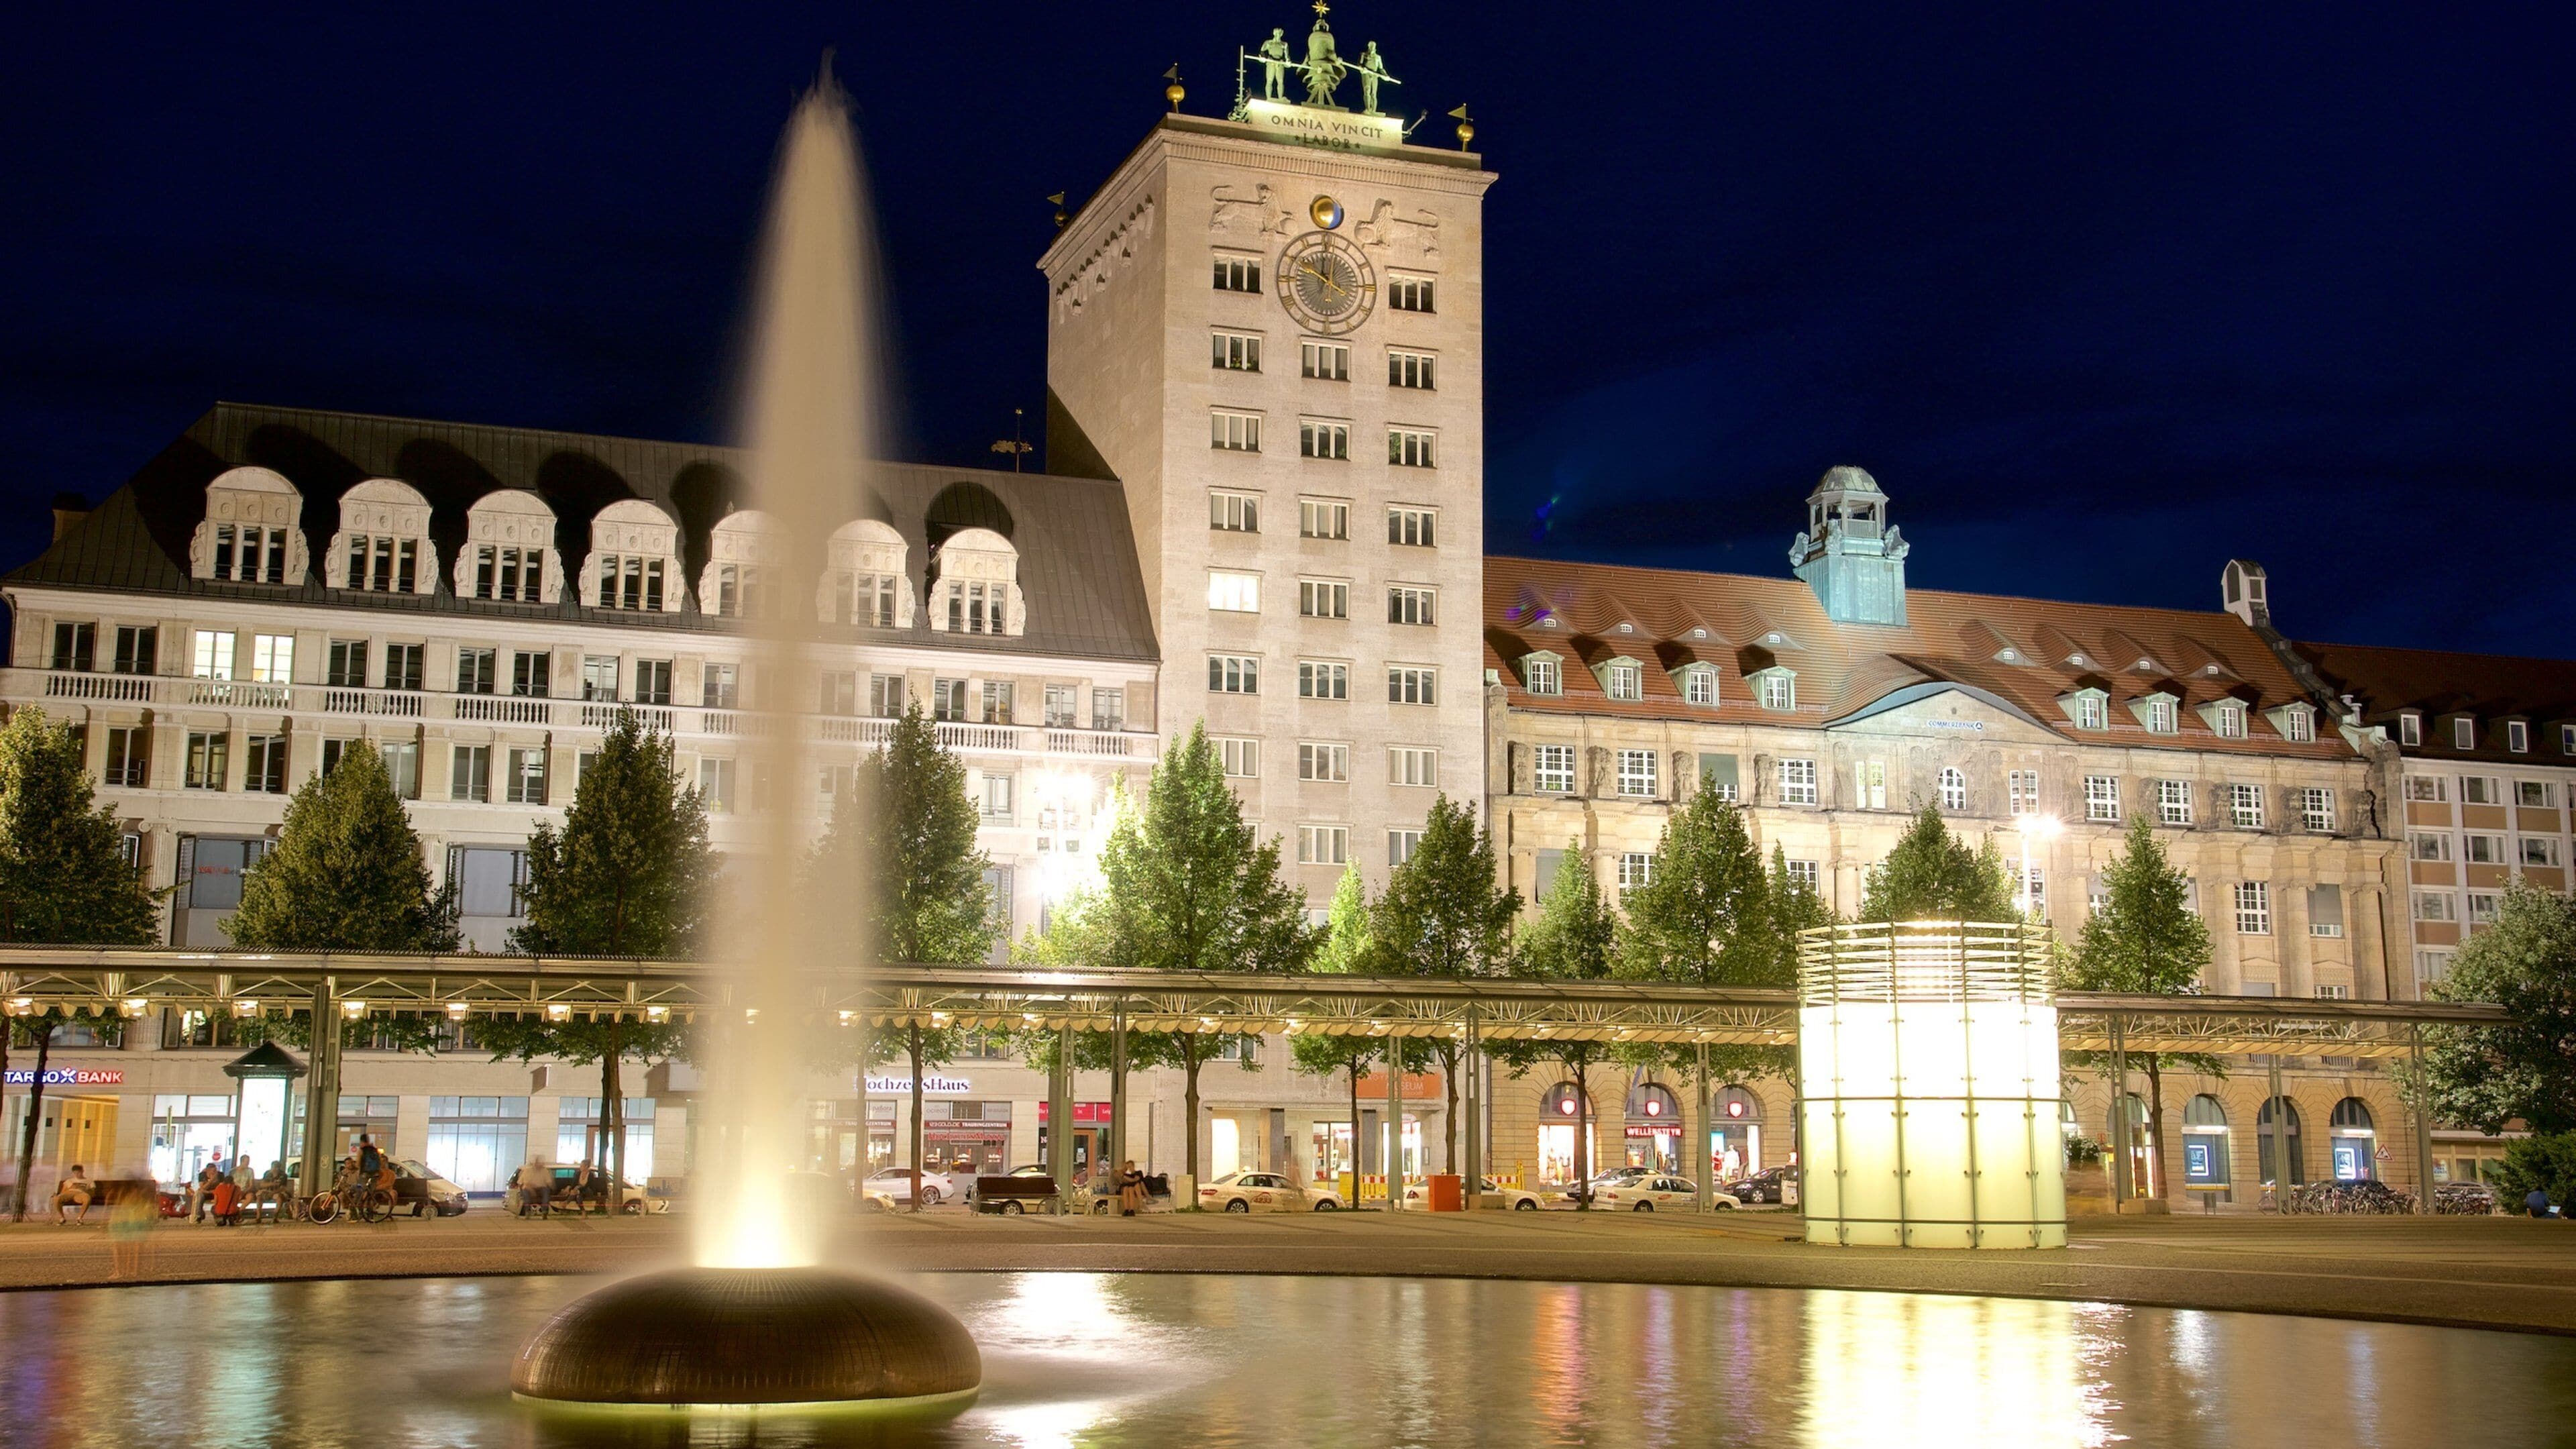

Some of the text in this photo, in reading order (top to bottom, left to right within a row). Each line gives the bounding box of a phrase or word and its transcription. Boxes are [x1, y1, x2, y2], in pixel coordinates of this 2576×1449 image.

[1271, 115, 1383, 139] OMNIA VINCIT
[1303, 133, 1351, 149] LABOR
[1928, 720, 1975, 729] COMMERZBANK
[4, 1071, 123, 1083] TARO BANK
[1626, 1127, 1681, 1136] WELLENSTEYN
